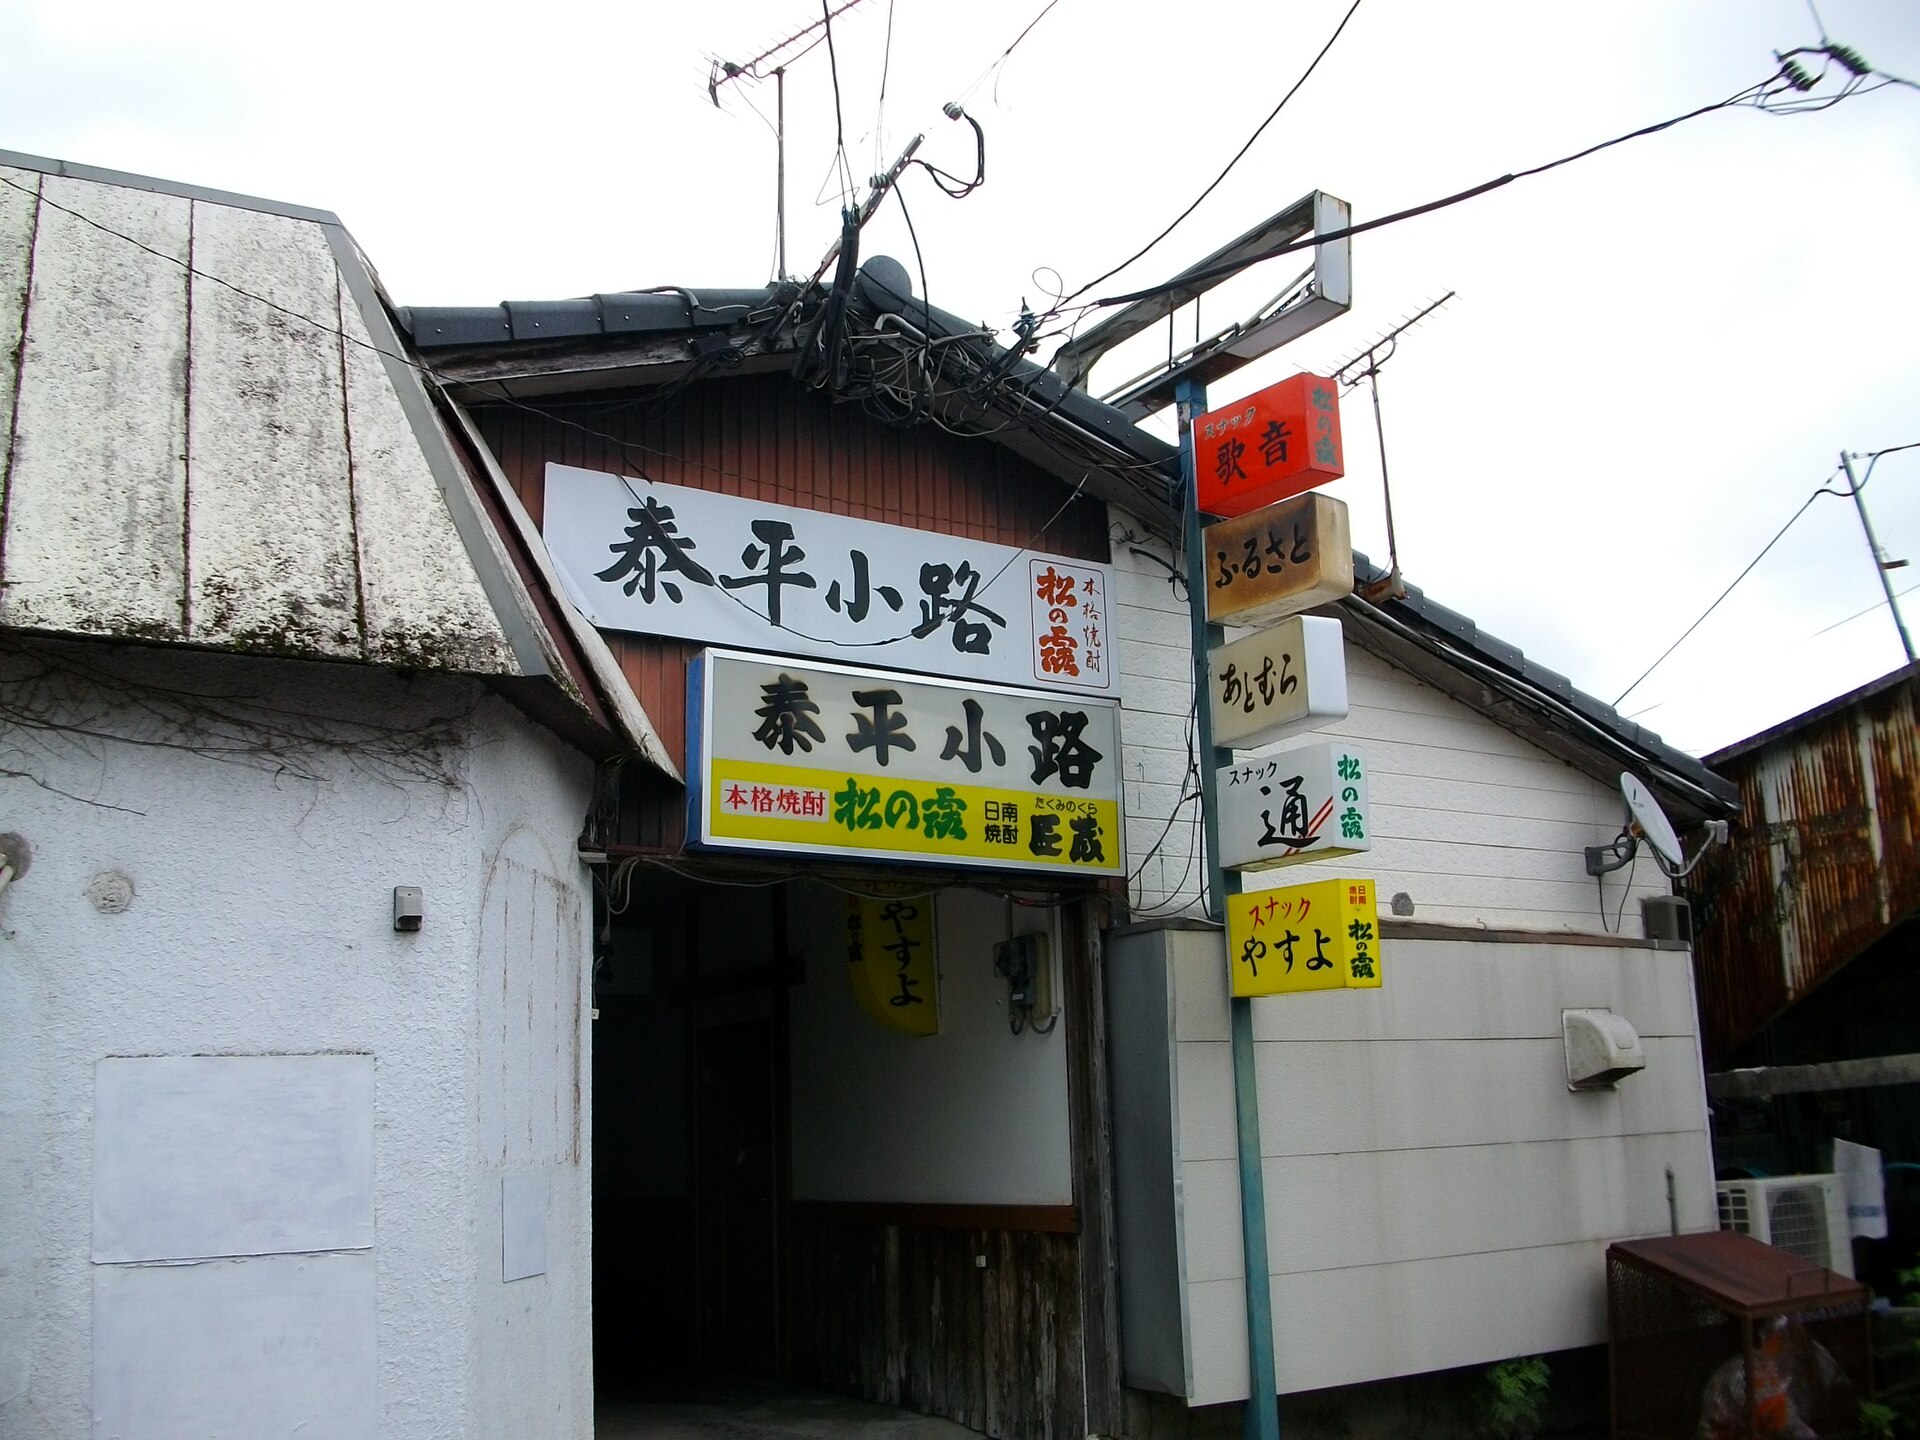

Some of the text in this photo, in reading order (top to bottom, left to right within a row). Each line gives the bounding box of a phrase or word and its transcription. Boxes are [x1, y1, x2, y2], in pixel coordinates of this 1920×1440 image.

[1204, 406, 1256, 440] スナック
[1215, 420, 1292, 486] 歌音
[593, 496, 1006, 655] 泰平小路
[1215, 522, 1313, 588] ふるさと
[1082, 578, 1102, 673] 本格焼酎
[751, 672, 1103, 790] 泰平小路
[1228, 761, 1278, 787] スナック
[725, 783, 826, 817] 本格焼酎
[984, 801, 1018, 823] 日南
[1035, 797, 1098, 815] たくみのくら
[1257, 775, 1321, 848] 通
[984, 823, 1018, 845] 焼酎
[1248, 897, 1312, 932] スナック
[880, 900, 923, 1007] やすよ
[1241, 928, 1333, 977] やすよ
